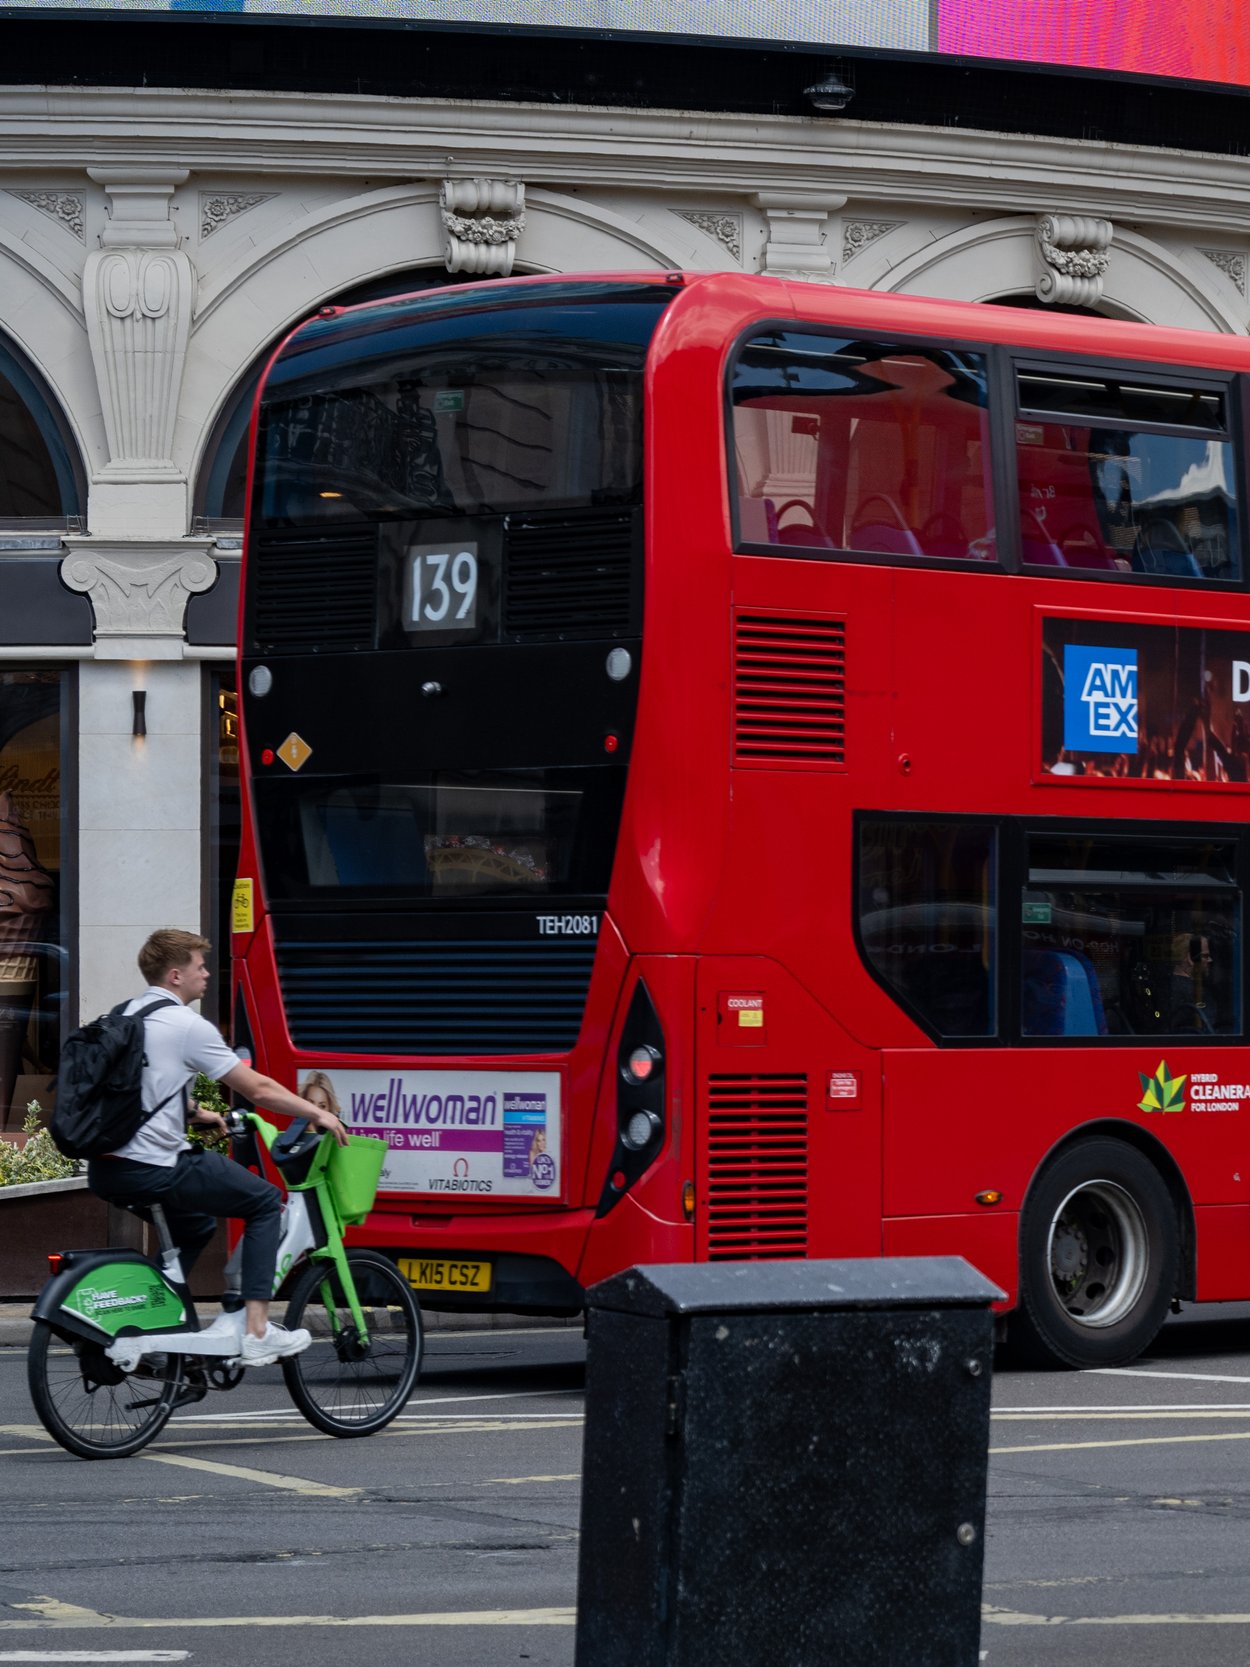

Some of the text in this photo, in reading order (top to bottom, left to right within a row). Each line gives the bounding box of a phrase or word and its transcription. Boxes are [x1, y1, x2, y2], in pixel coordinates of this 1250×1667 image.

[411, 551, 477, 621] 139
[536, 915, 598, 934] TEH2081
[728, 998, 763, 1008] COOLANT
[1190, 1073, 1218, 1083] HYBRID
[351, 1078, 496, 1126] wellwoman
[1190, 1102, 1239, 1112] FOR LONDON
[383, 1130, 404, 1147] life
[408, 1131, 440, 1147] well
[428, 1178, 493, 1192] VITABIOTICS
[408, 1262, 481, 1287] LK15 CSZ
[91, 1290, 118, 1301] HAVE
